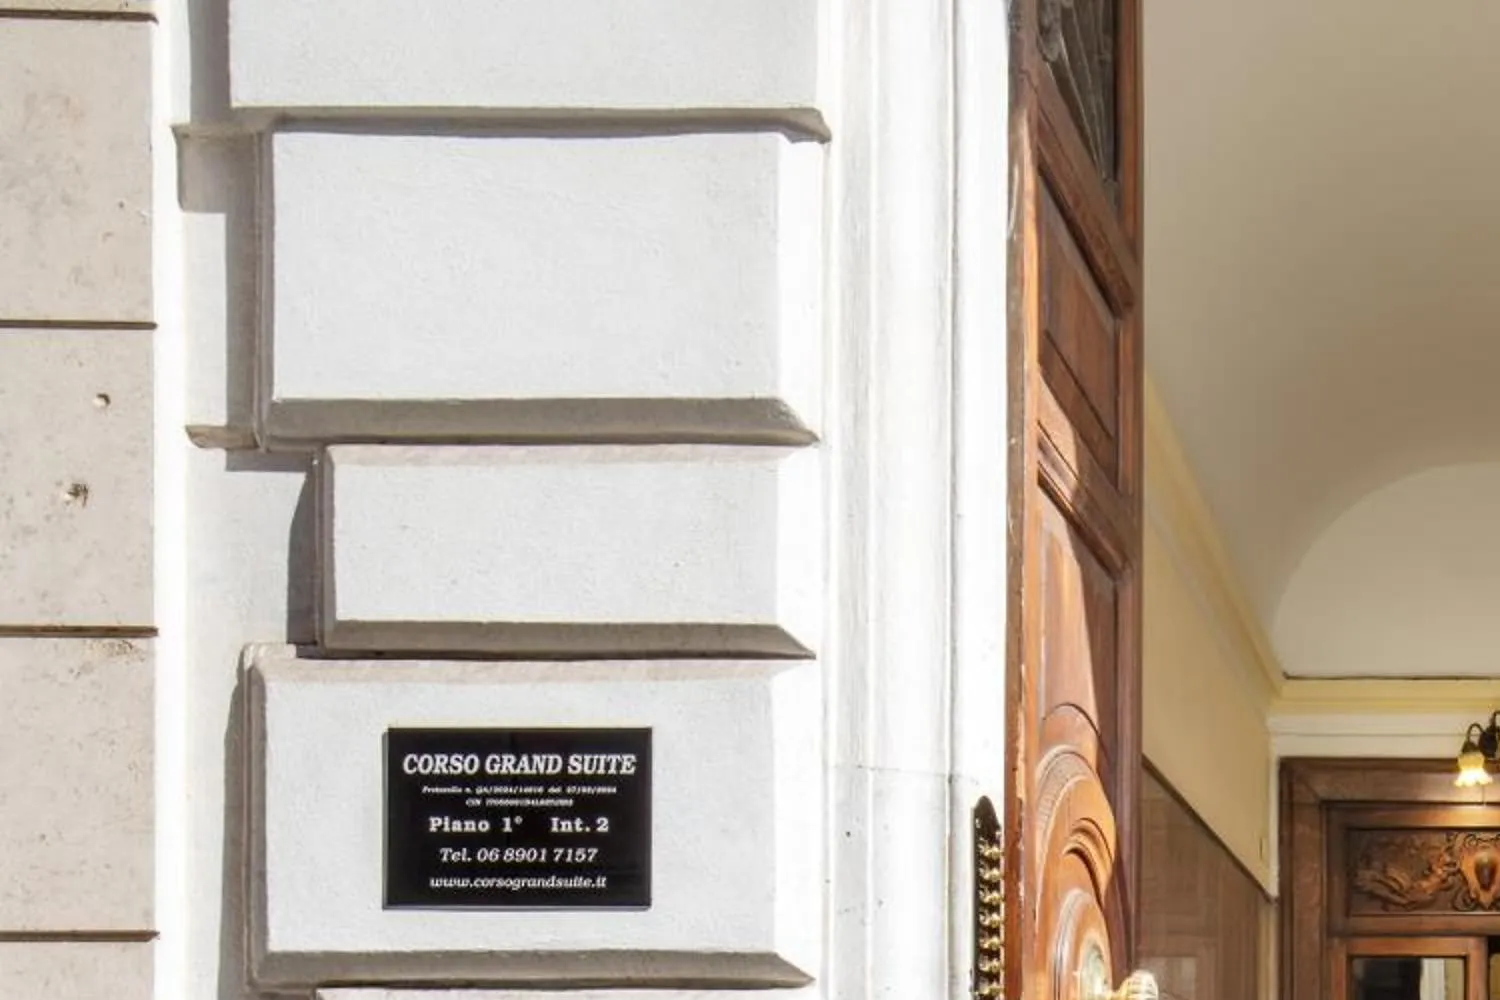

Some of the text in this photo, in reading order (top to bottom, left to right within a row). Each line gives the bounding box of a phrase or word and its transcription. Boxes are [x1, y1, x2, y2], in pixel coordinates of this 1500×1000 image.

[403, 753, 636, 775] CORSO GRAND SUITE
[429, 816, 490, 832] Piano
[551, 817, 590, 833] Int.
[596, 817, 609, 832] 2
[440, 848, 598, 862] Tel. 06 8901 7157
[430, 875, 607, 891] www.corsograndsuite.it
